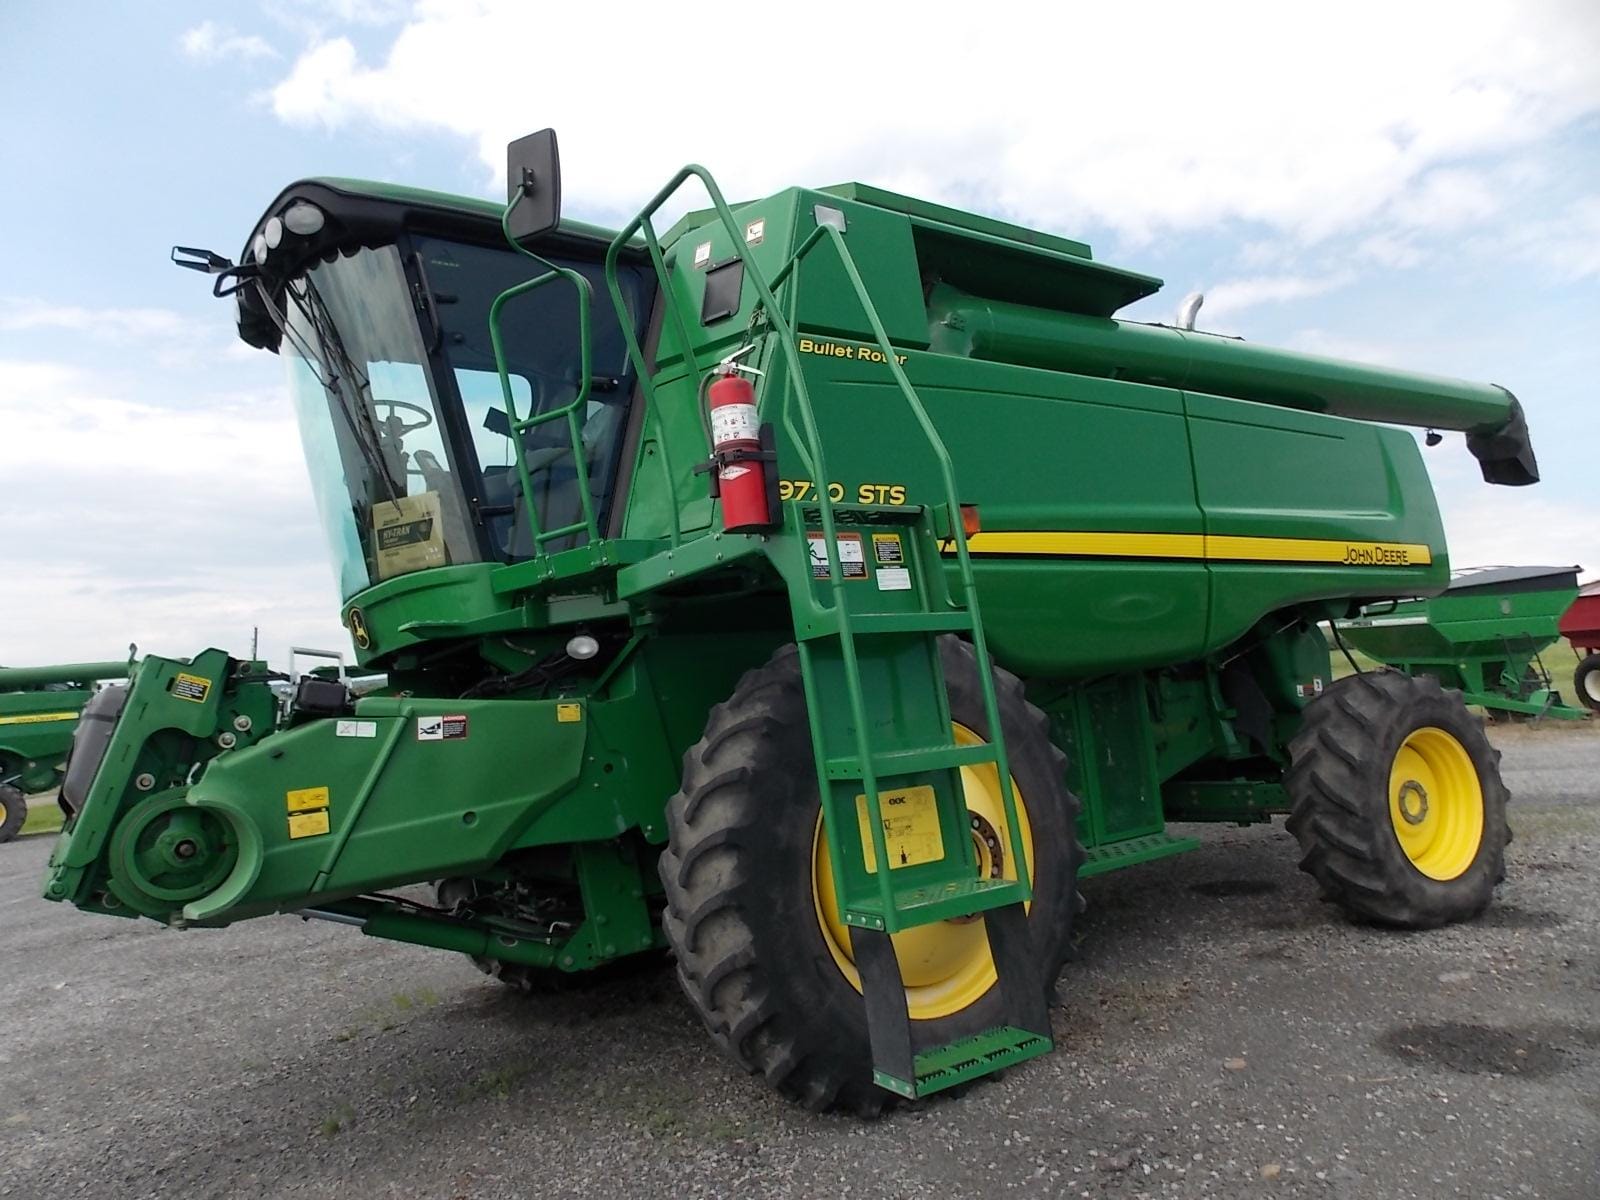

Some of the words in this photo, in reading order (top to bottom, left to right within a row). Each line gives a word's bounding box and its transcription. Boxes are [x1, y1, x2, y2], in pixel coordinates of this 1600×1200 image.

[799, 339, 853, 358] Bullet
[858, 484, 905, 505] STS
[1343, 545, 1373, 562] JOHN
[1375, 546, 1409, 563] DEERE
